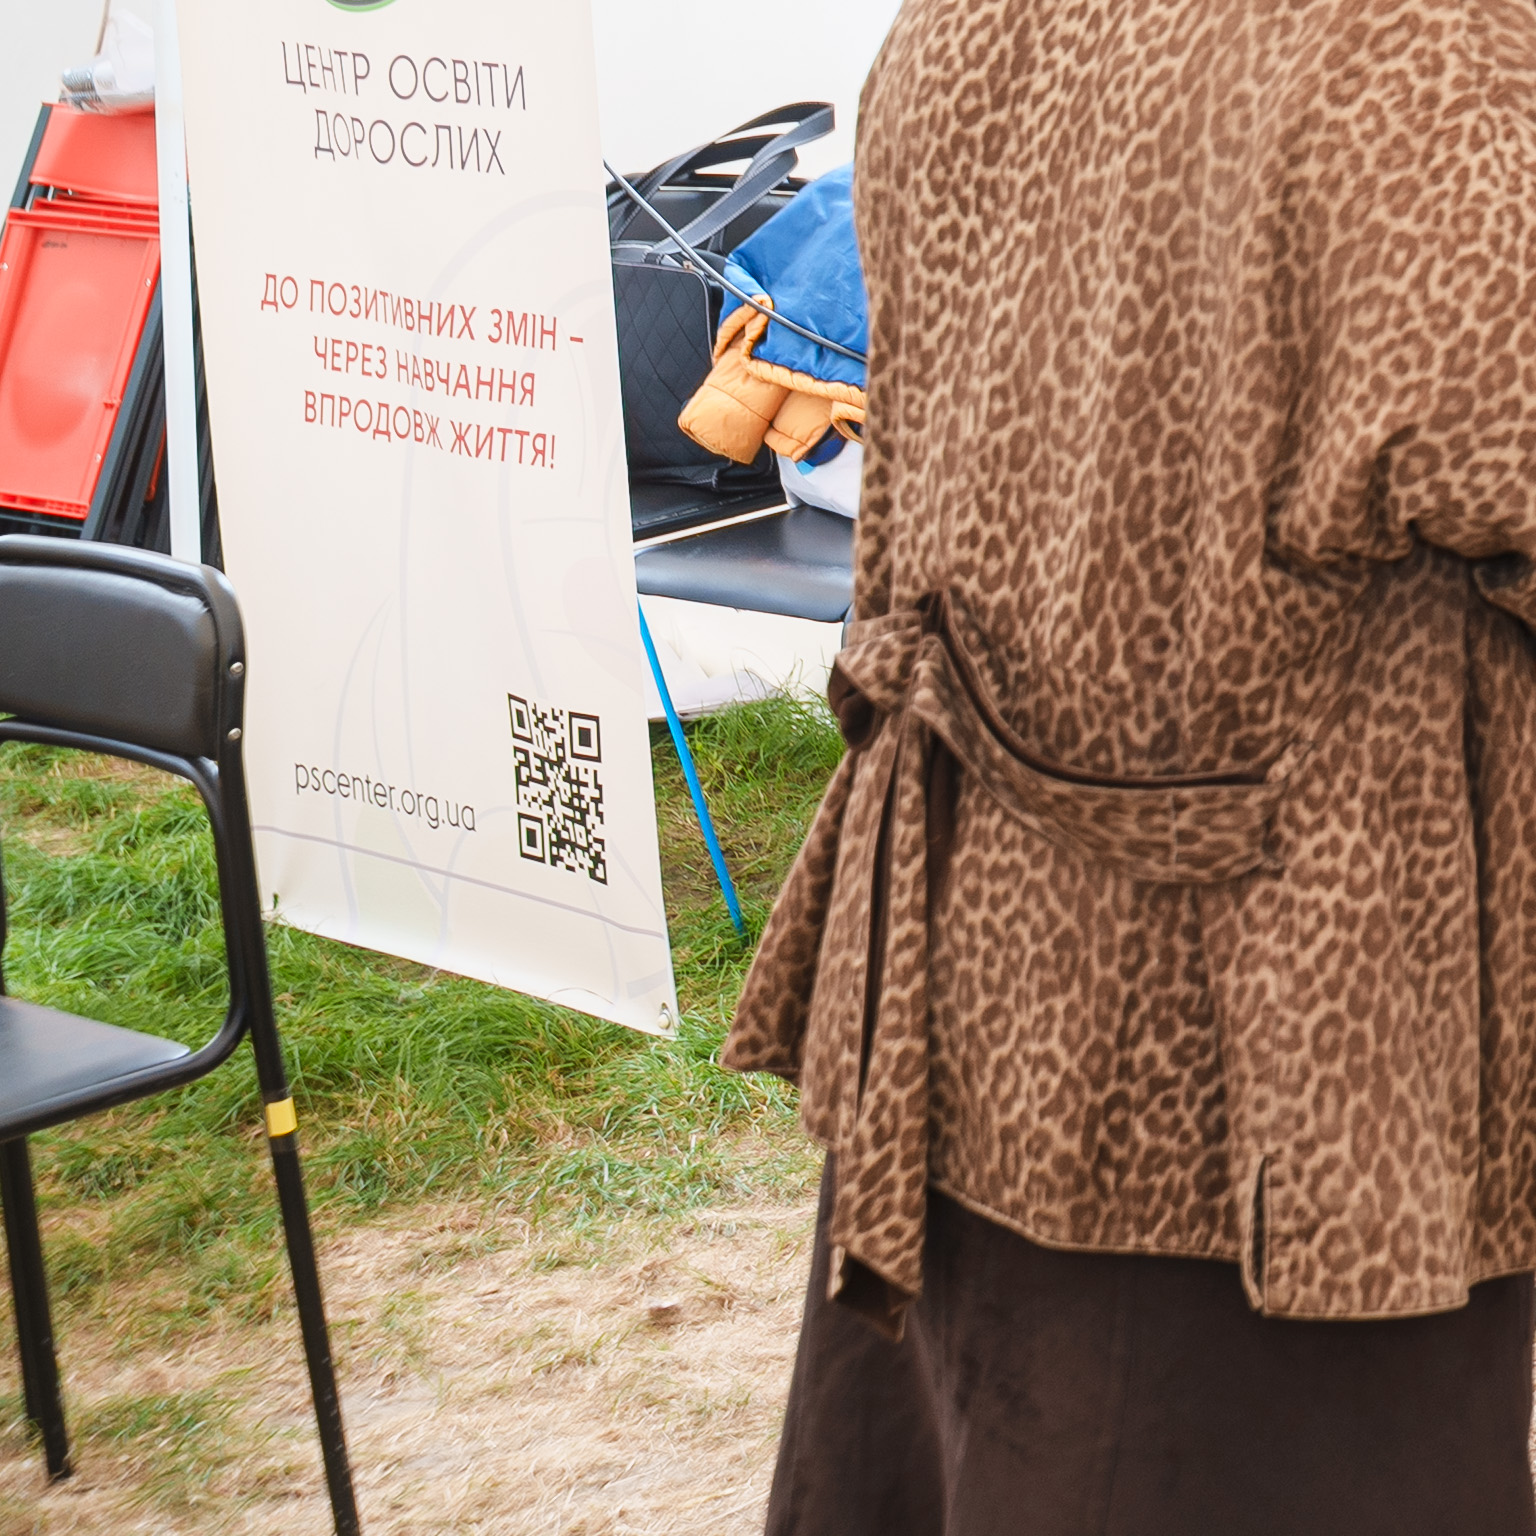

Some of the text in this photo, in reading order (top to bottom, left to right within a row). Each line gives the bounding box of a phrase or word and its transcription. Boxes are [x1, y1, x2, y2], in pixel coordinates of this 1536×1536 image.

[281, 41, 526, 111] ЦЕНТР ОСВІТИ
[314, 108, 506, 176] ДОРОСЛИХ
[261, 272, 298, 313] ДО
[309, 278, 477, 341] ПОЗИТИВНИХ
[487, 308, 557, 351] ЗМІН
[314, 335, 536, 408] ЧЕРЕЗ НАВЧАННЯ
[304, 389, 556, 470] ВПРОДОВЖ ЖИТТЯ!
[294, 762, 477, 832] pscenter.org.ua
